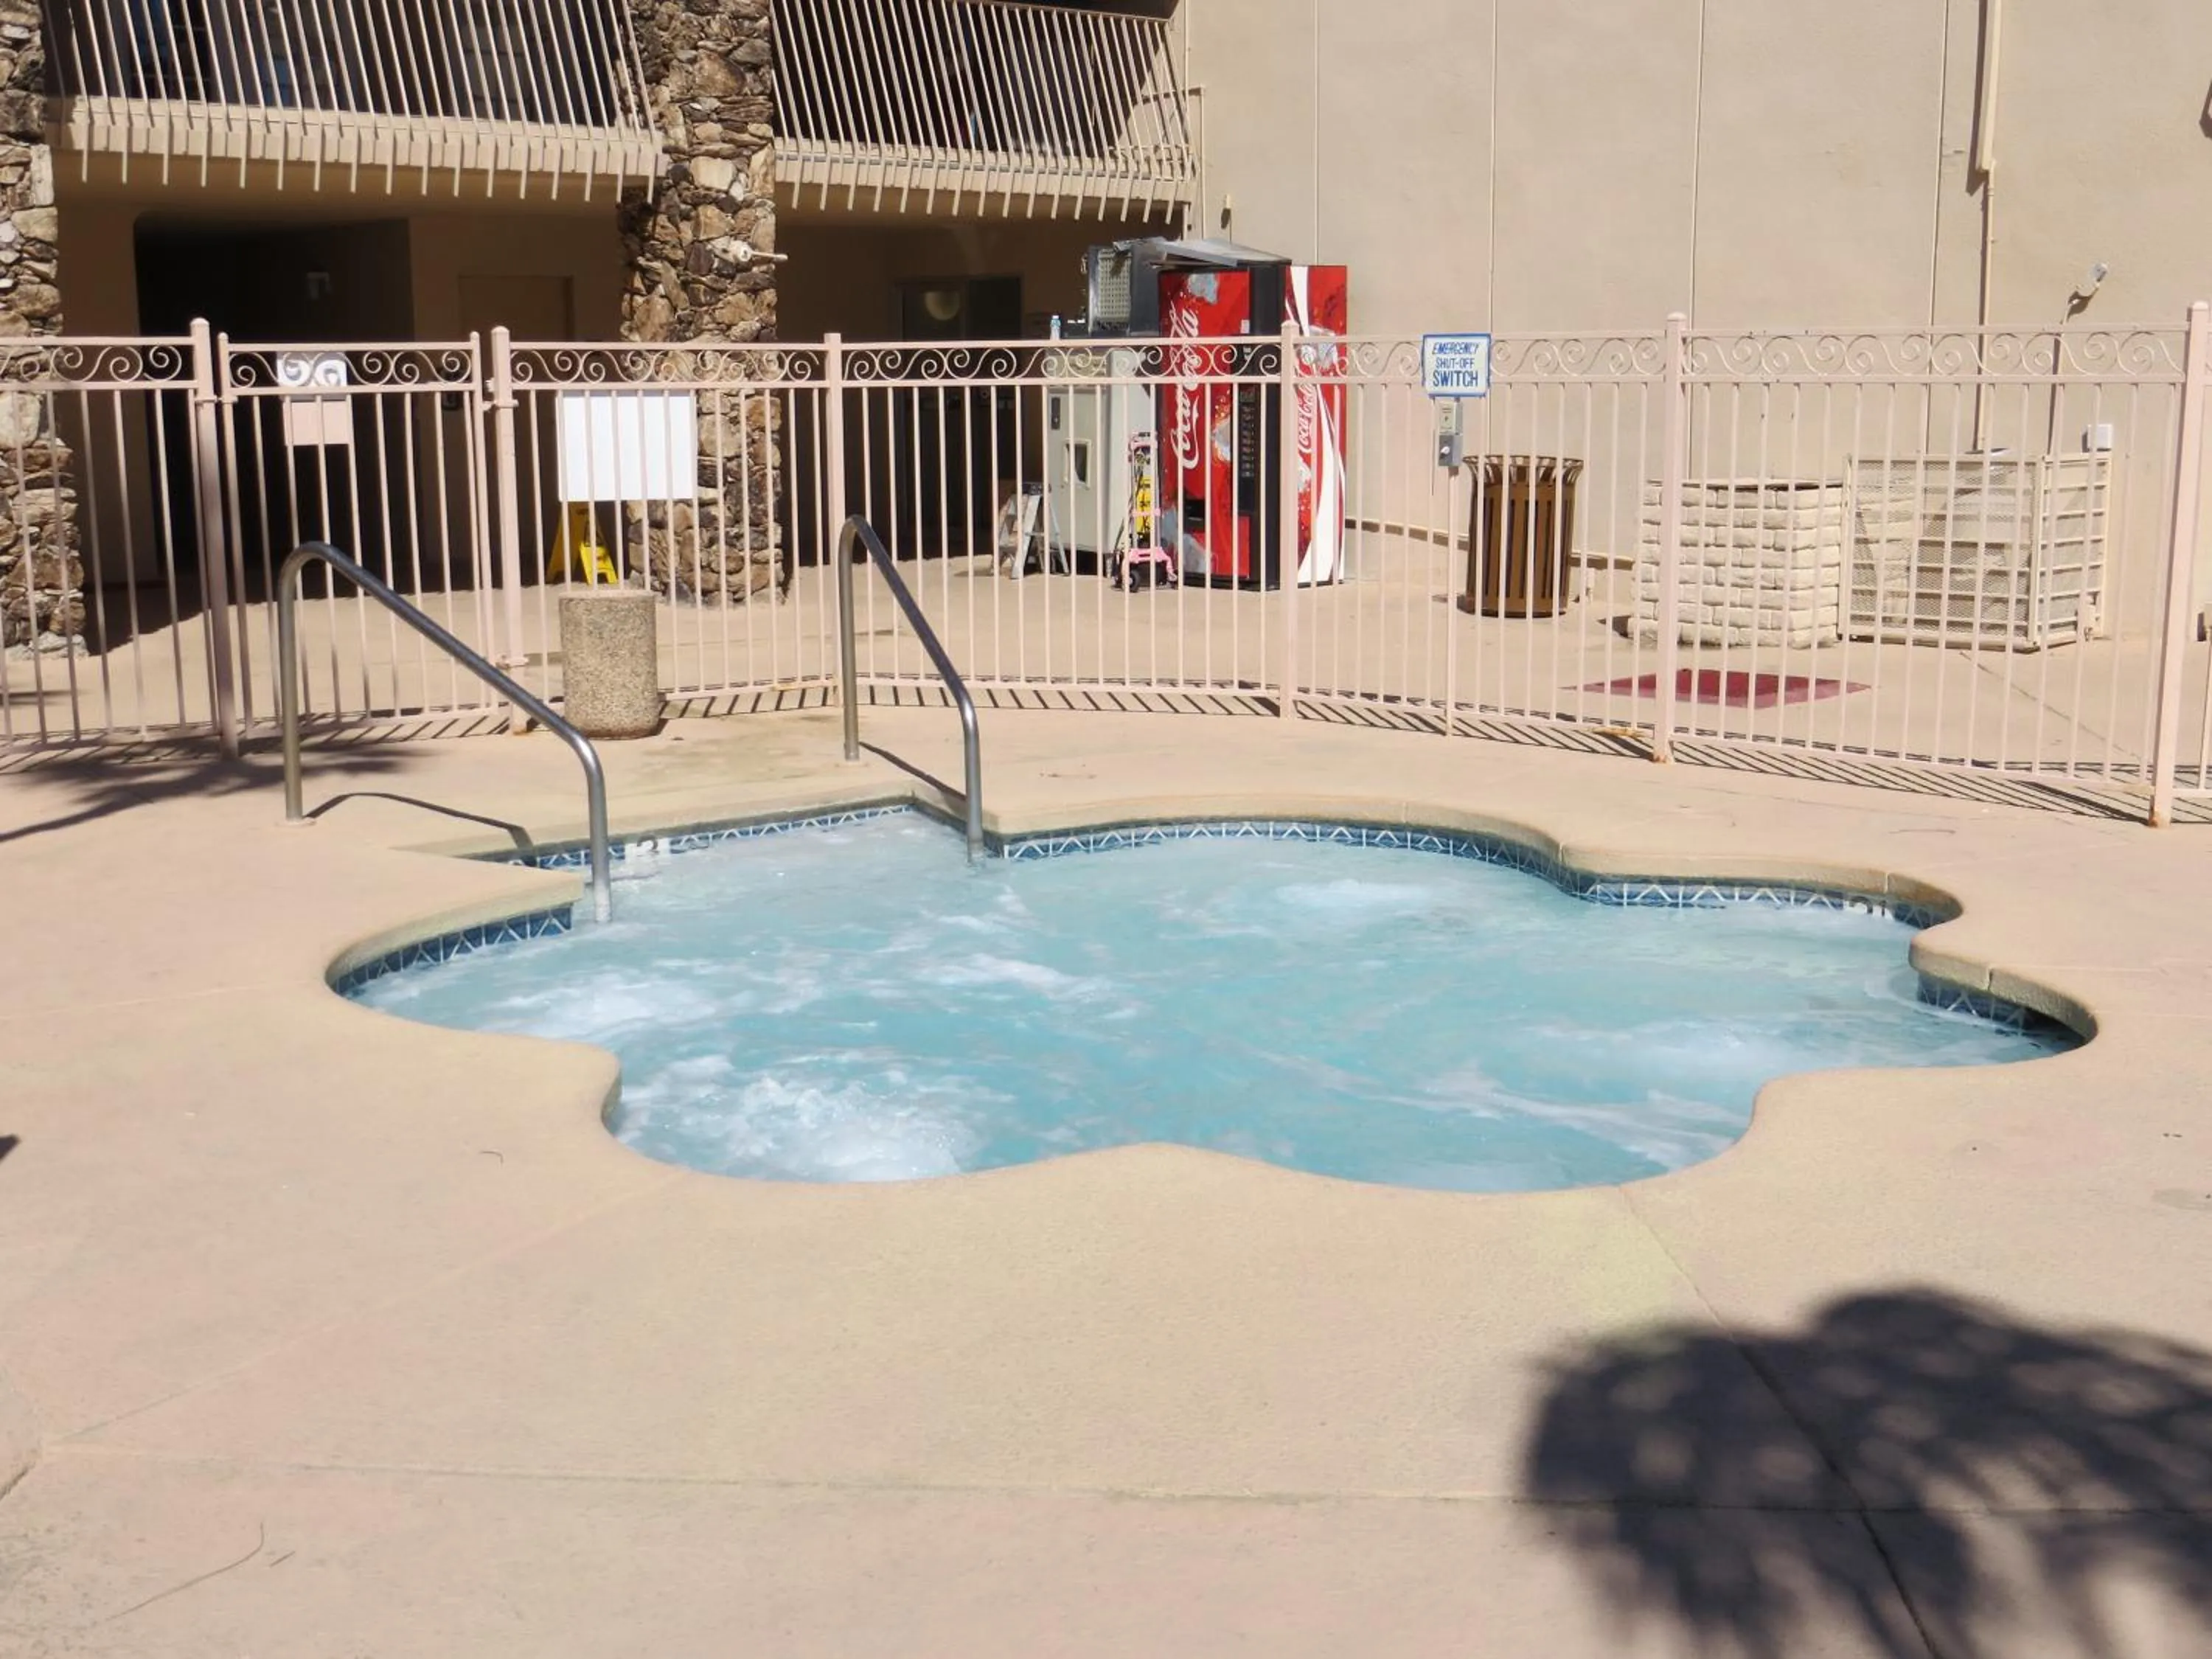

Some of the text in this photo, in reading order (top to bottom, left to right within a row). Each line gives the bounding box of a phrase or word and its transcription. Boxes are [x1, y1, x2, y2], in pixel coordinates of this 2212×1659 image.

[1432, 341, 1480, 355] EMERGENCY
[1436, 357, 1475, 369] SHUT-OFF
[1169, 300, 1199, 469] CocaCola
[1433, 370, 1478, 387] SWITCH
